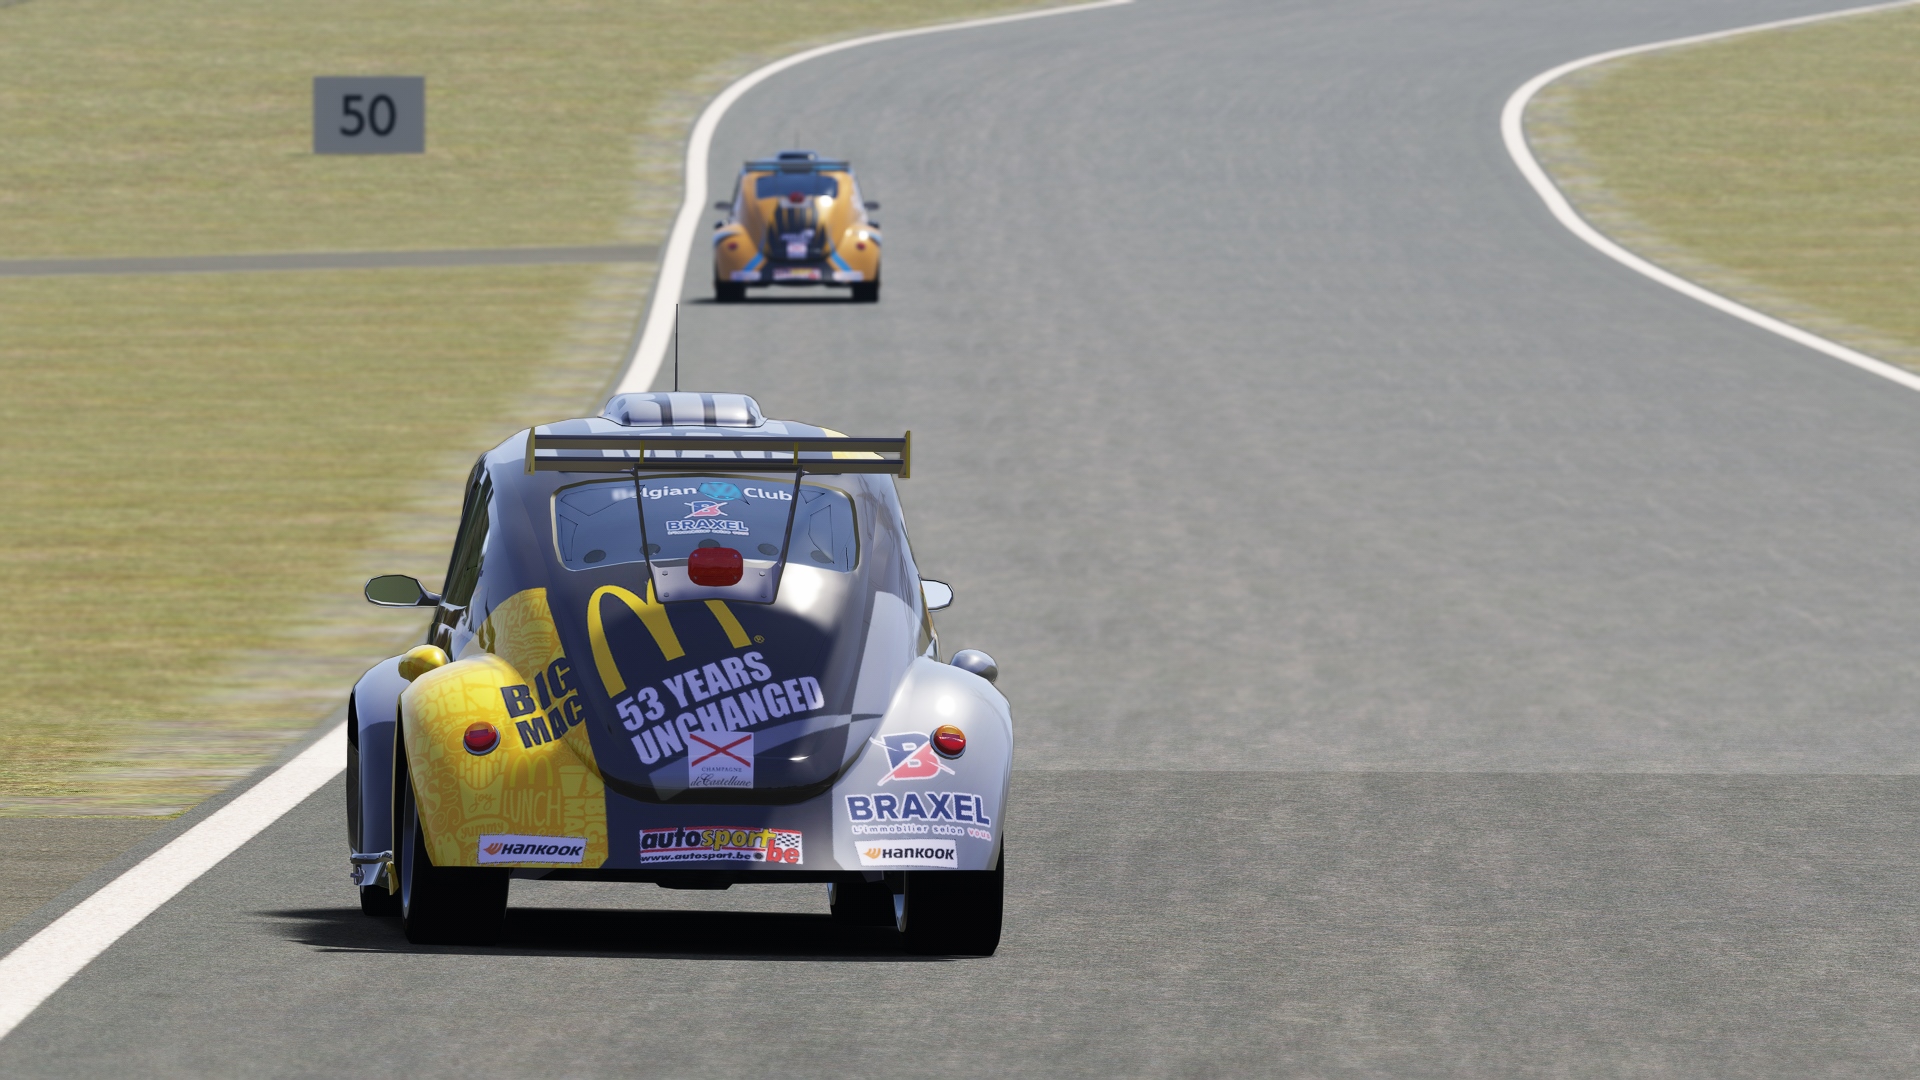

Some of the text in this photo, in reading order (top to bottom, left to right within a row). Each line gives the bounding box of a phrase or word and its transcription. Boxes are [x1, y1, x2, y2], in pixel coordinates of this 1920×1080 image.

[340, 93, 397, 137] 50
[743, 487, 793, 501] Club
[666, 519, 749, 532] BRAXEL
[500, 657, 577, 719] BIG
[615, 651, 772, 731] 53 YEARS
[515, 694, 587, 749] MAC
[630, 676, 825, 765] UNCHANGED
[468, 793, 496, 814] joy
[503, 788, 561, 827] LUNCH
[846, 792, 991, 826] BRAXEL
[461, 821, 504, 840] yummy
[641, 828, 777, 851] autosport
[853, 825, 991, 840] L'immobilier selon vous
[641, 851, 752, 862] www.autosport.be
